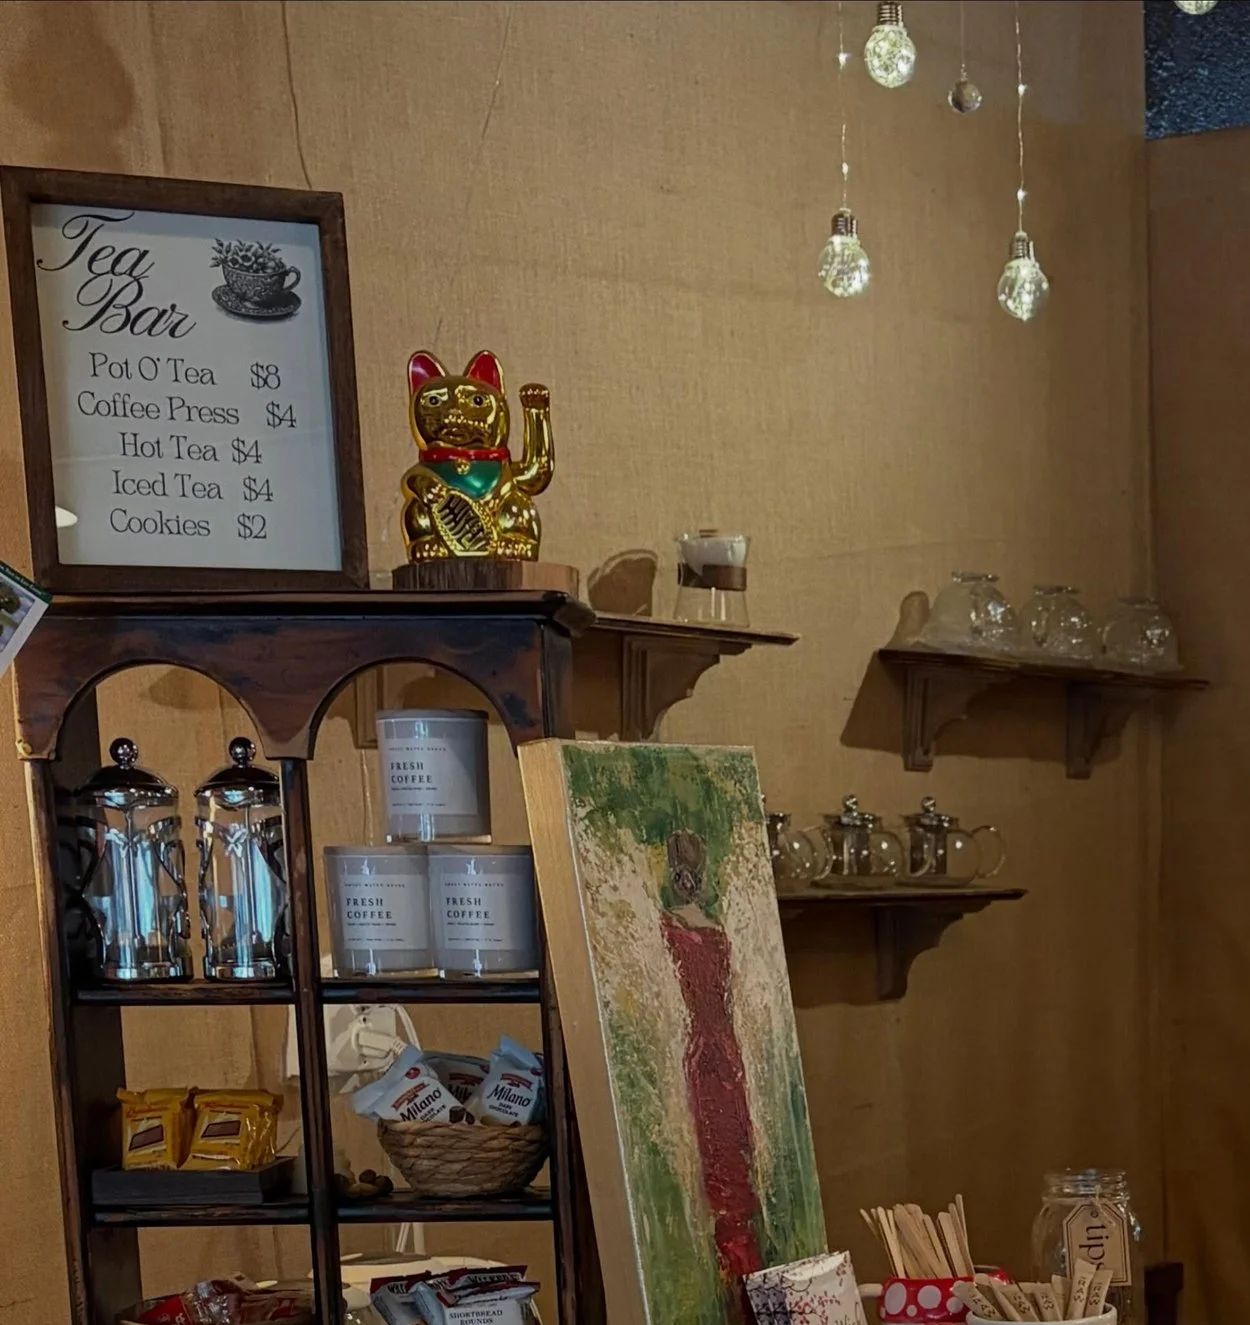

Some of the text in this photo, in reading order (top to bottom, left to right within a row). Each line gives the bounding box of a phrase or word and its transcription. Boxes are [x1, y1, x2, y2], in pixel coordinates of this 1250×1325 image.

[37, 211, 155, 278] Tea
[62, 274, 197, 339] Bar
[89, 351, 133, 381] Pot
[168, 358, 218, 386] Tea
[250, 362, 281, 390] $8
[77, 390, 297, 429] Coffee Press $4
[119, 432, 263, 465] Hot Tea $4
[112, 469, 274, 503] Iced Tea $4
[109, 508, 268, 541] Cookies $2
[390, 761, 424, 771] FRESH
[391, 774, 433, 784] COFFEE
[346, 898, 383, 907] FRESH
[446, 897, 481, 906] FRESH
[347, 910, 393, 920] COFFEE
[447, 909, 490, 919] COFFEE
[400, 1088, 442, 1121] Milano
[487, 1084, 531, 1108] Milano
[449, 1309, 503, 1320] SHORTBREAD
[460, 1318, 494, 1325] ROUNDS
